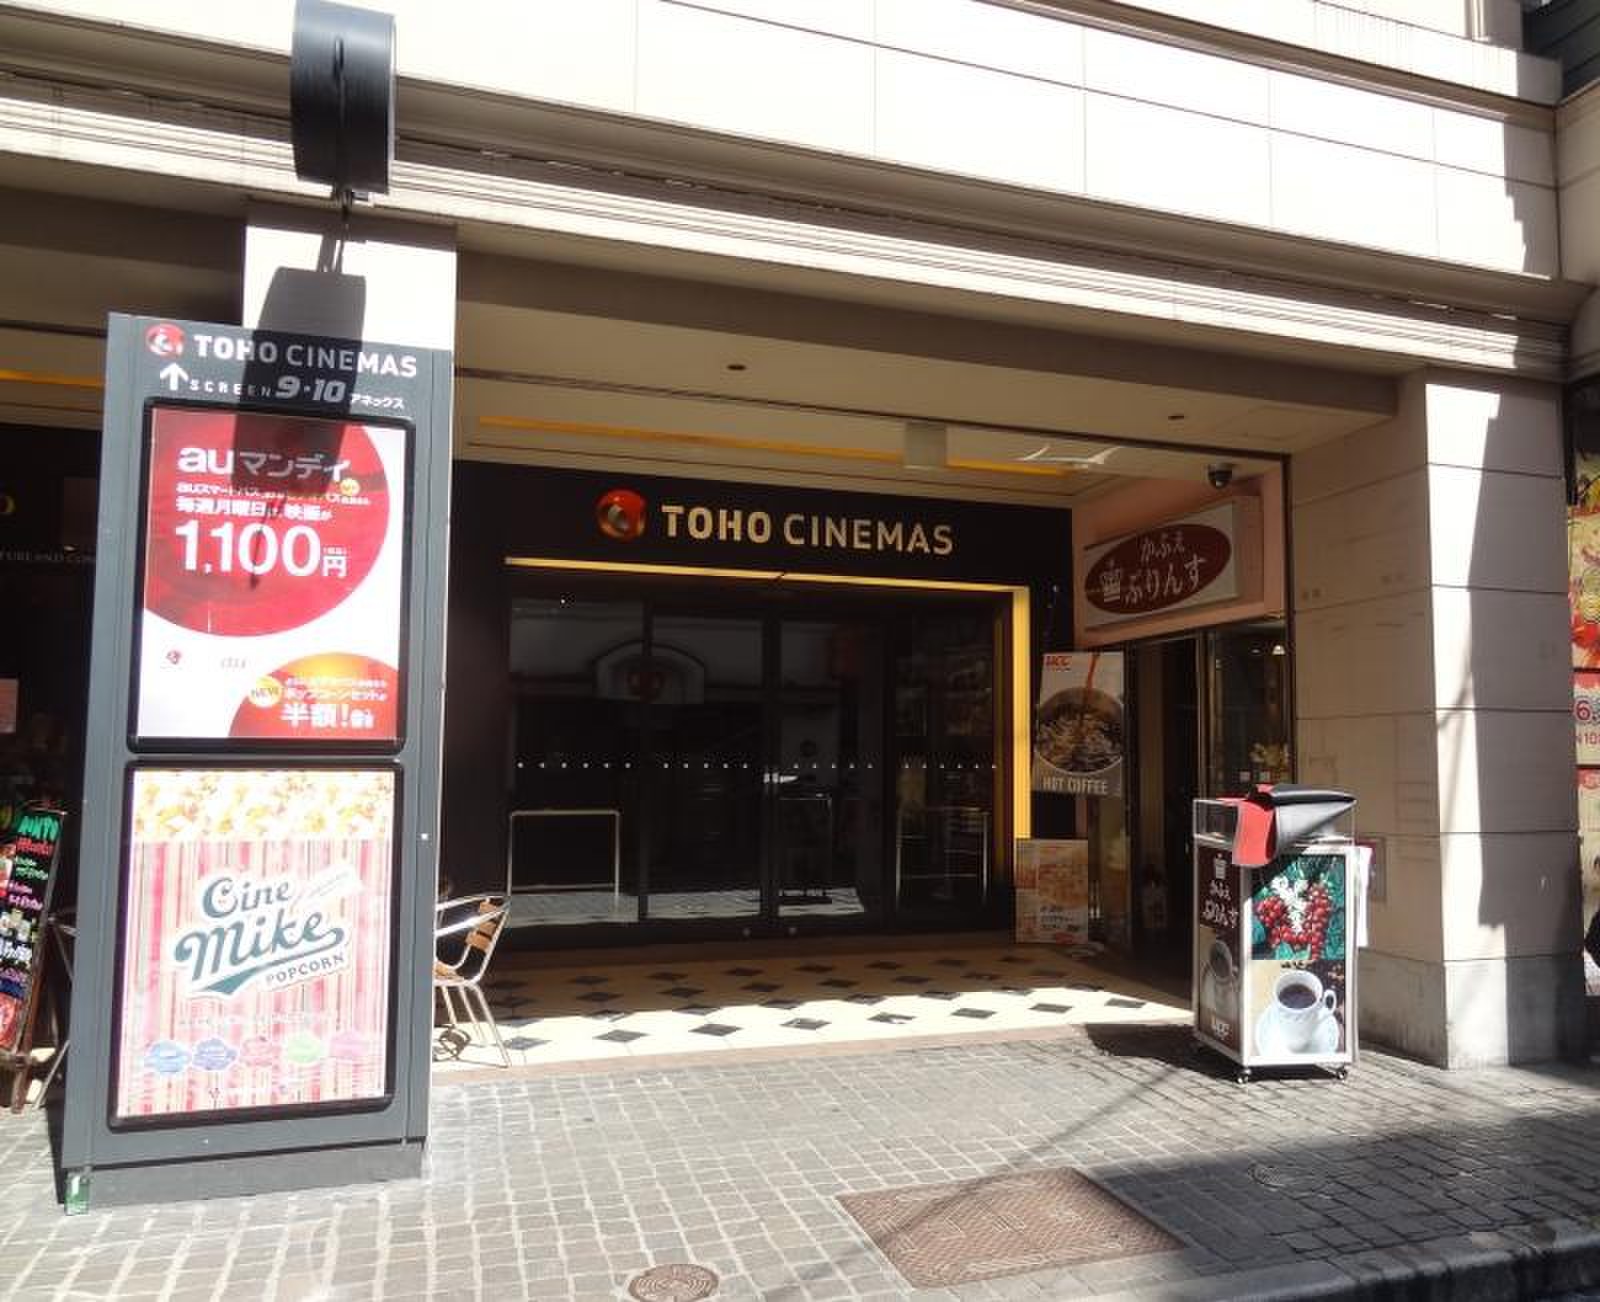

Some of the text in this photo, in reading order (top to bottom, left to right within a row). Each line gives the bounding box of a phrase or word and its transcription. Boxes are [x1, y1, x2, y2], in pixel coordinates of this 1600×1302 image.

[193, 334, 417, 378] TOHO CINEMAS
[190, 379, 271, 397] SCREEN
[660, 504, 953, 556] TOHO CINEMAS
[202, 876, 291, 919] Cine
[173, 908, 345, 984] Mike
[265, 952, 345, 985] POPCORN
